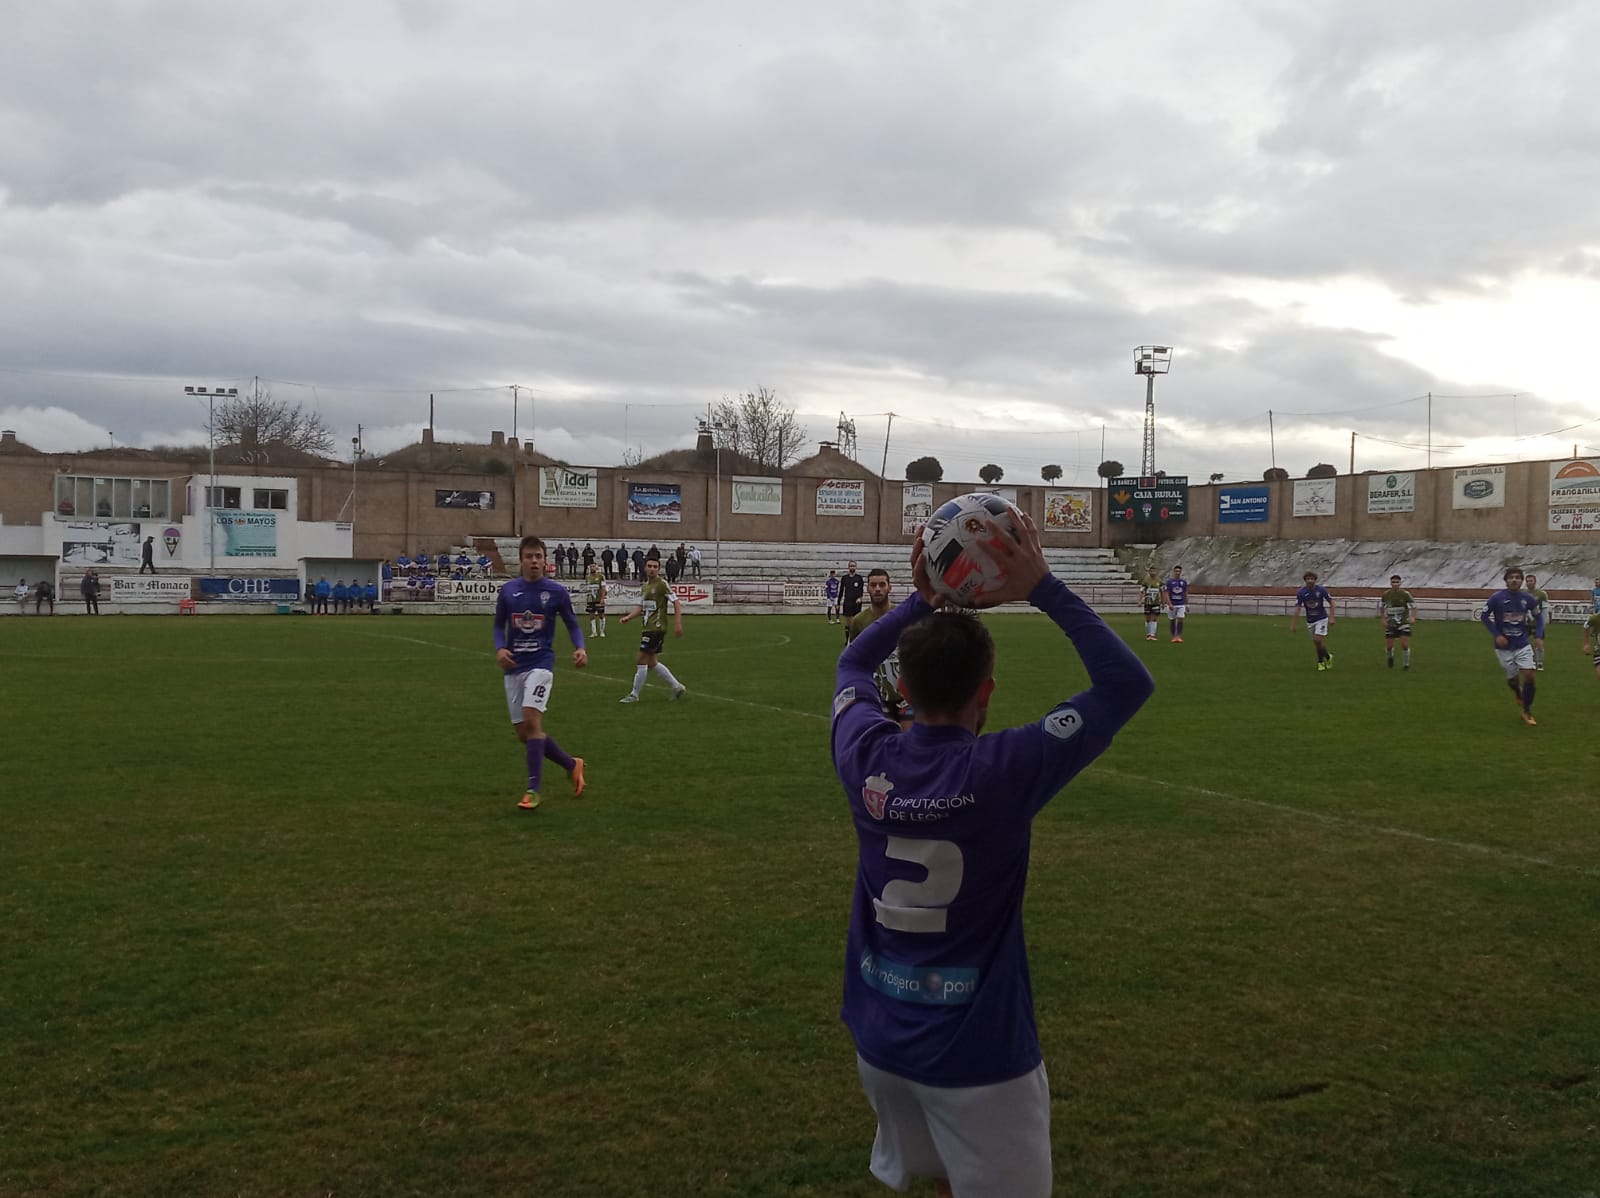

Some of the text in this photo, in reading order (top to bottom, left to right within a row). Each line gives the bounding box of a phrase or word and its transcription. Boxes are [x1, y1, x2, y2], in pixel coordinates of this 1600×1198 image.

[1134, 490, 1183, 499] CAJA RURAL
[1551, 488, 1600, 496] FRANGANILL
[1242, 496, 1268, 504] ANTONIO
[216, 517, 276, 525] LOS MAYOS
[113, 579, 189, 591] Bar Monaco
[228, 578, 272, 594] CHE
[456, 582, 503, 594] Autoba
[533, 685, 546, 698] 18
[891, 793, 976, 810] DIPUTACIÓN
[889, 809, 906, 822] DE
[872, 835, 964, 933] 2
